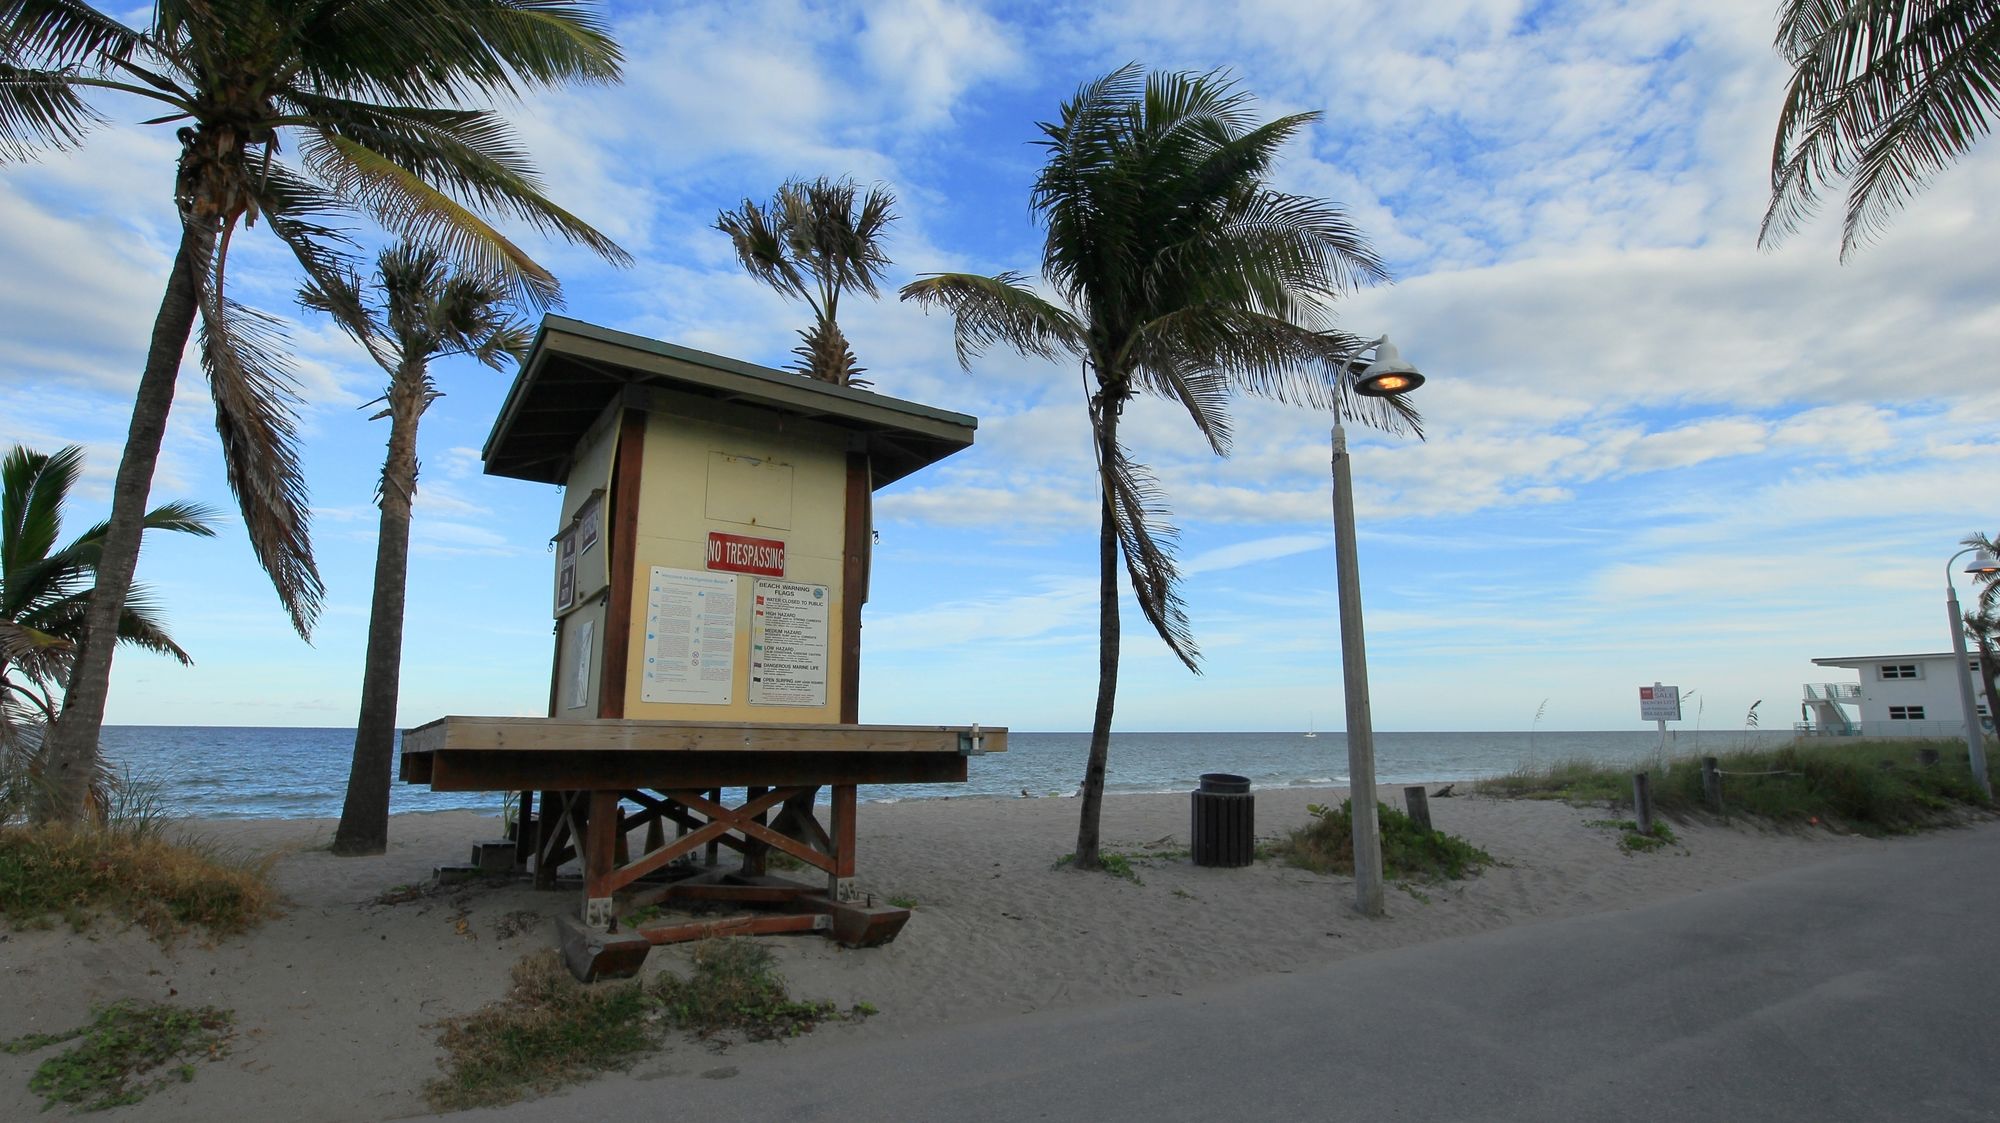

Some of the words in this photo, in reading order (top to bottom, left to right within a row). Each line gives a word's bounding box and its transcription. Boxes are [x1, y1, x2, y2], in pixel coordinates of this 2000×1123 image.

[708, 539, 721, 562] NO
[726, 542, 784, 570] TRESPASSING
[782, 584, 810, 592] WARNING
